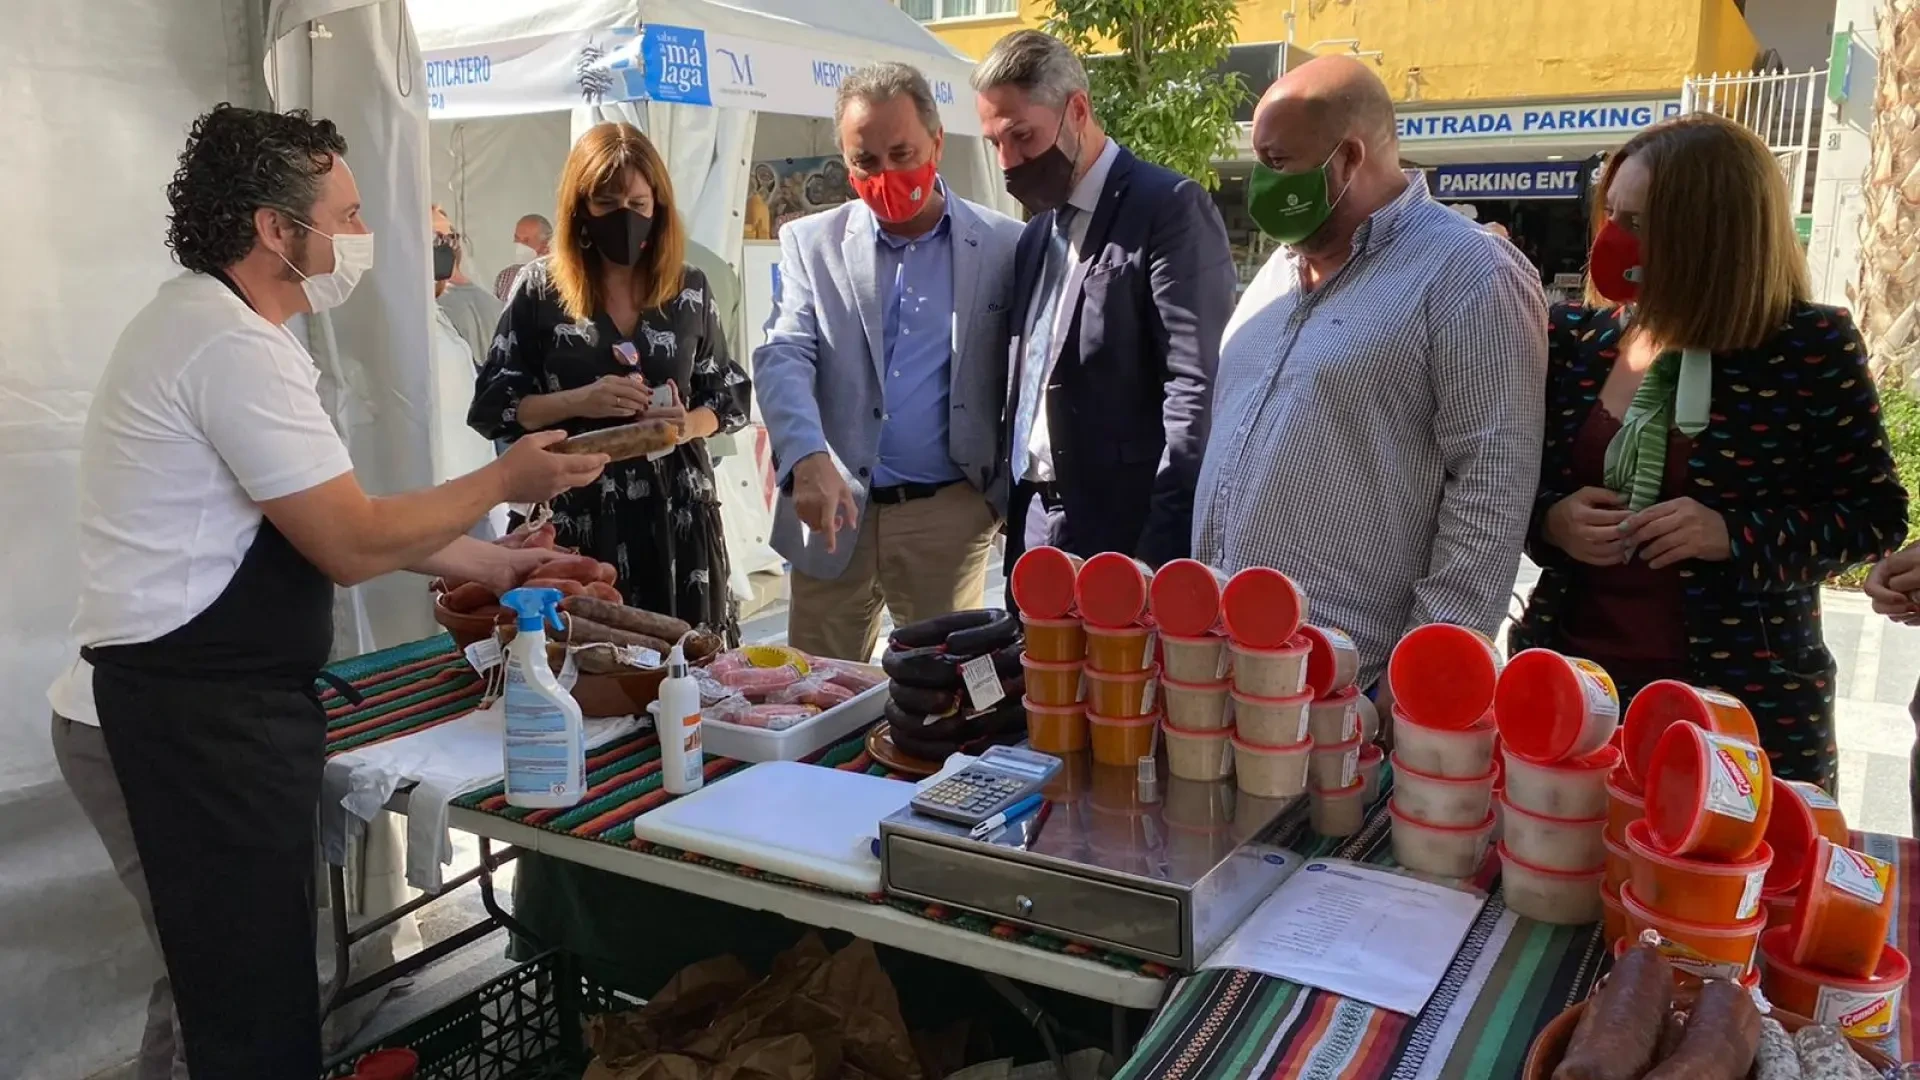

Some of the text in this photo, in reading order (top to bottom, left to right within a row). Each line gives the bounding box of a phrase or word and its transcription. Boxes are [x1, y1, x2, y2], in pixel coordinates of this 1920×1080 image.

[666, 38, 702, 67] má
[660, 55, 702, 93] laga
[1523, 107, 1651, 131] PARKING
[1439, 173, 1532, 192] PARKING
[1535, 170, 1578, 190] ENT
